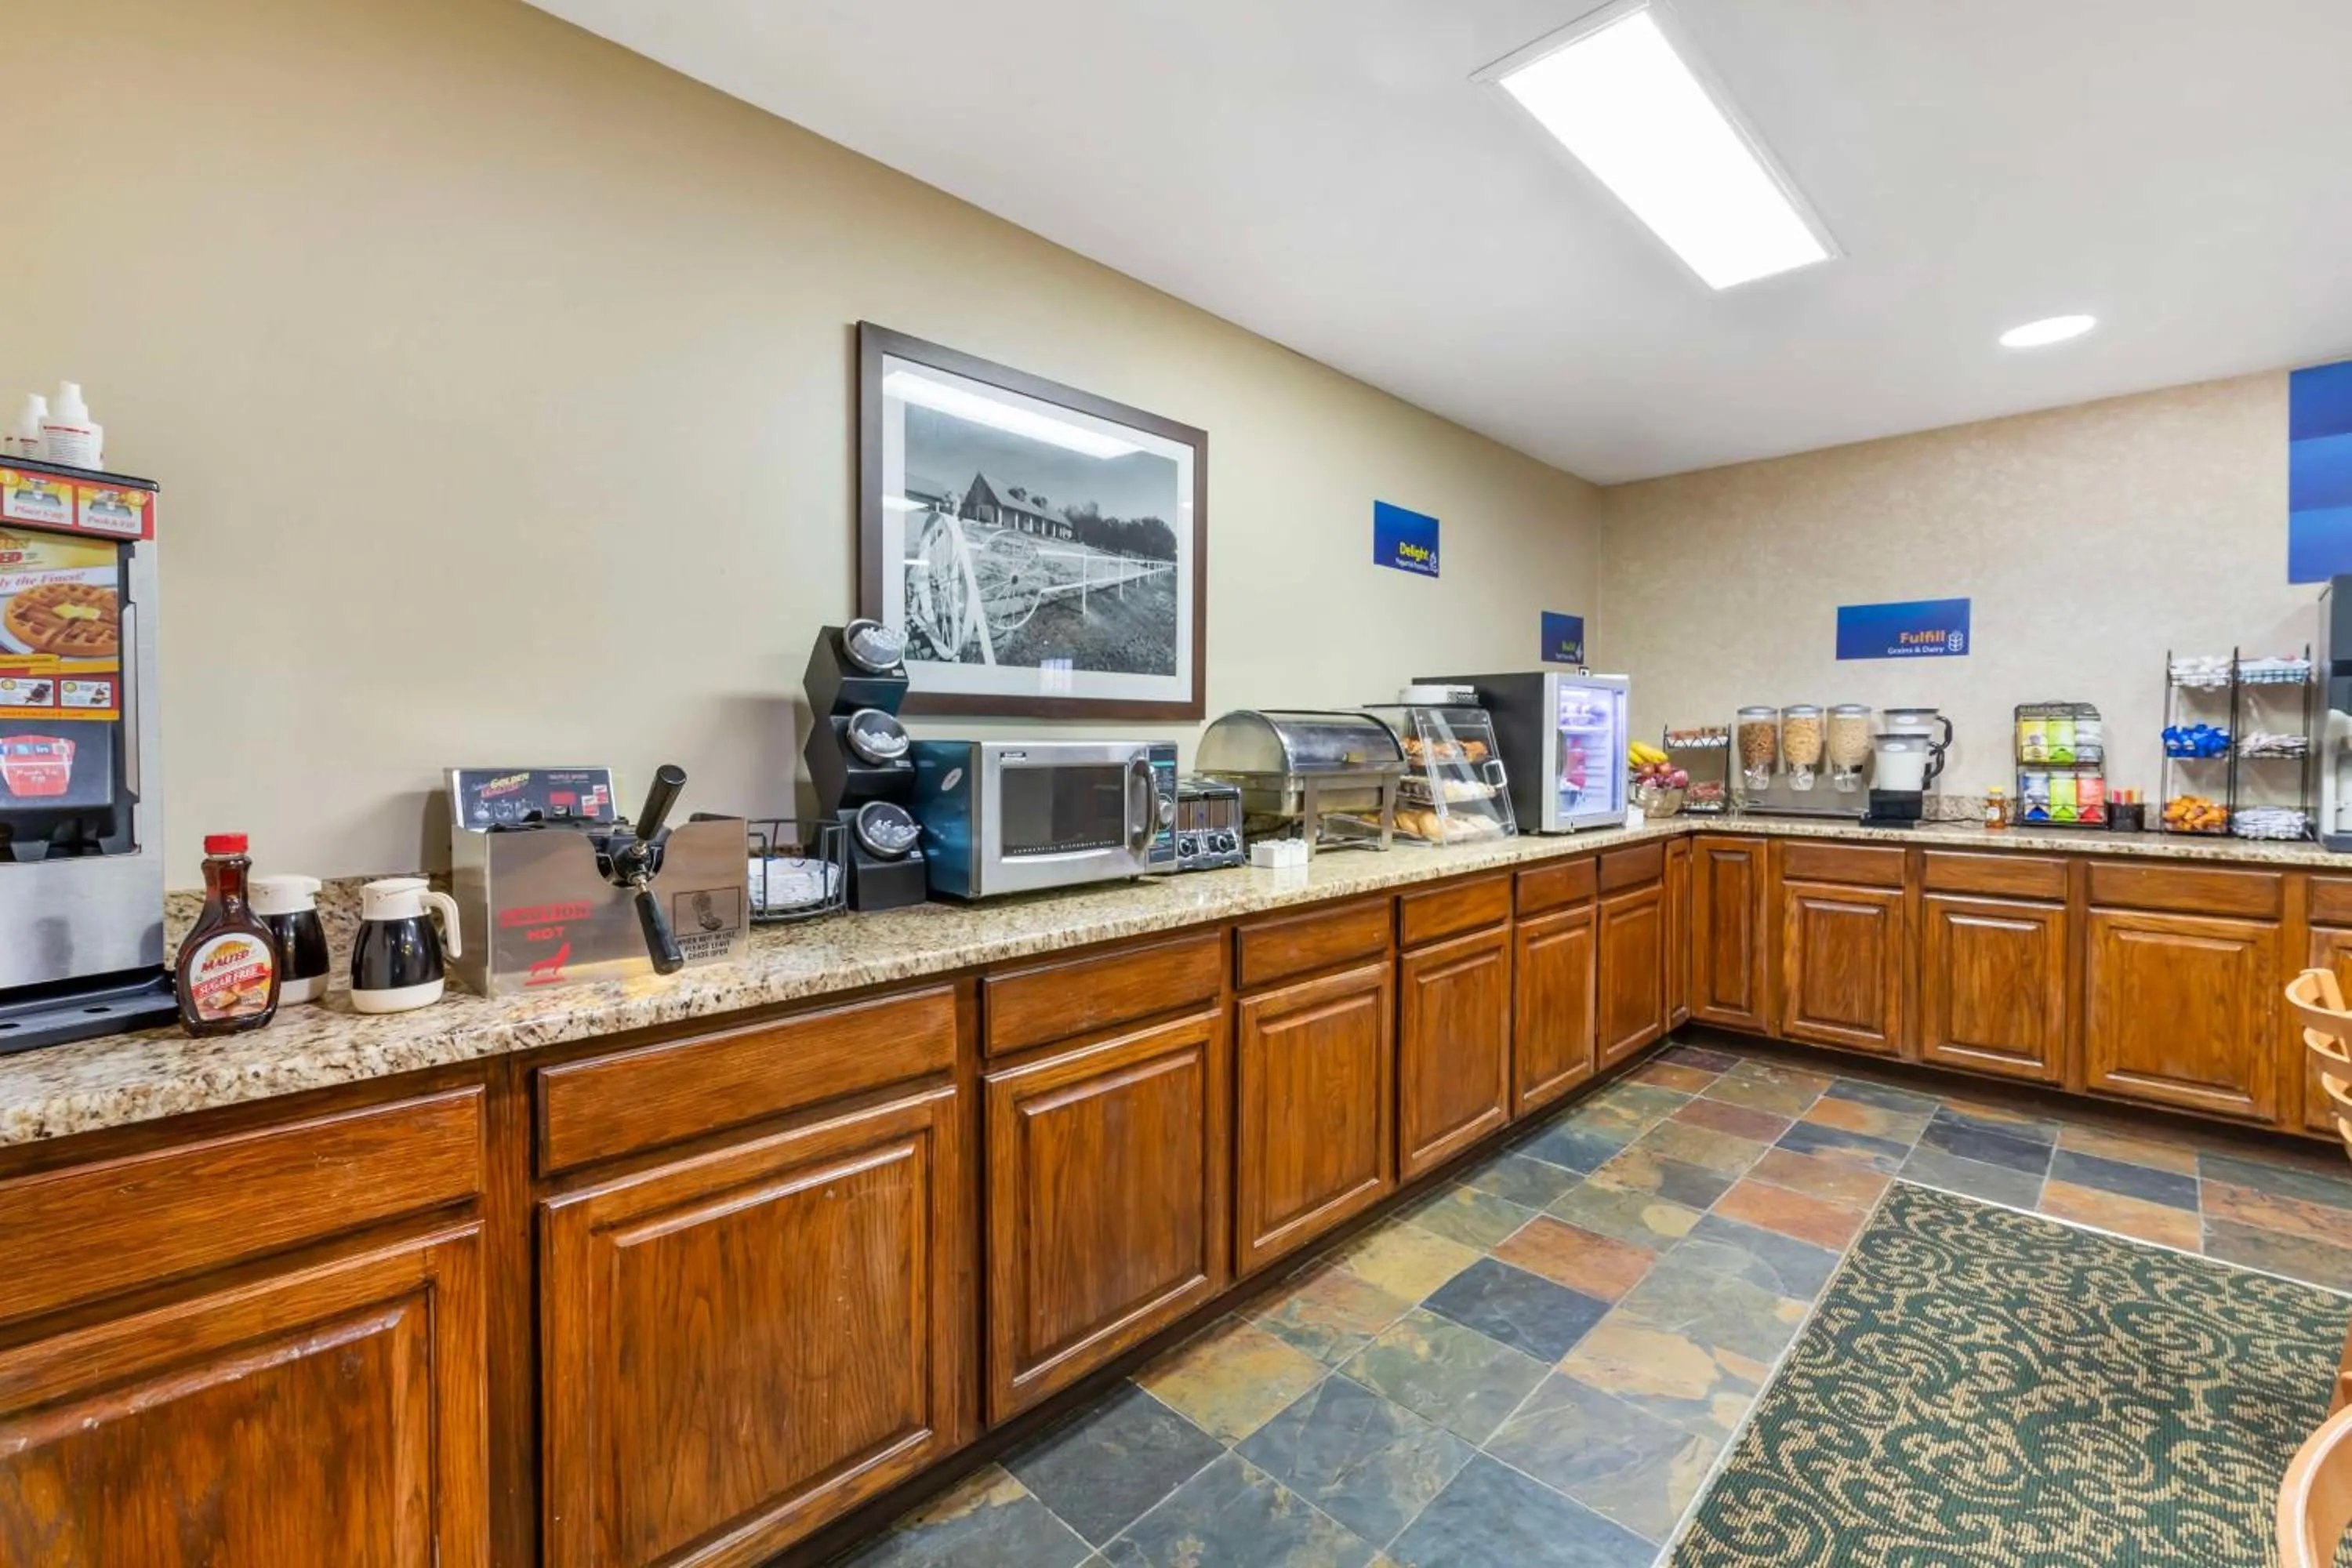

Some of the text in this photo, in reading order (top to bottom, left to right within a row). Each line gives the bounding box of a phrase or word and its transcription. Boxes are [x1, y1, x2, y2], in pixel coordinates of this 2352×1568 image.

[1399, 542, 1428, 561] Delight
[1900, 630, 1945, 643] Fulfill
[526, 926, 565, 941] HOT
[234, 965, 260, 983] FREE
